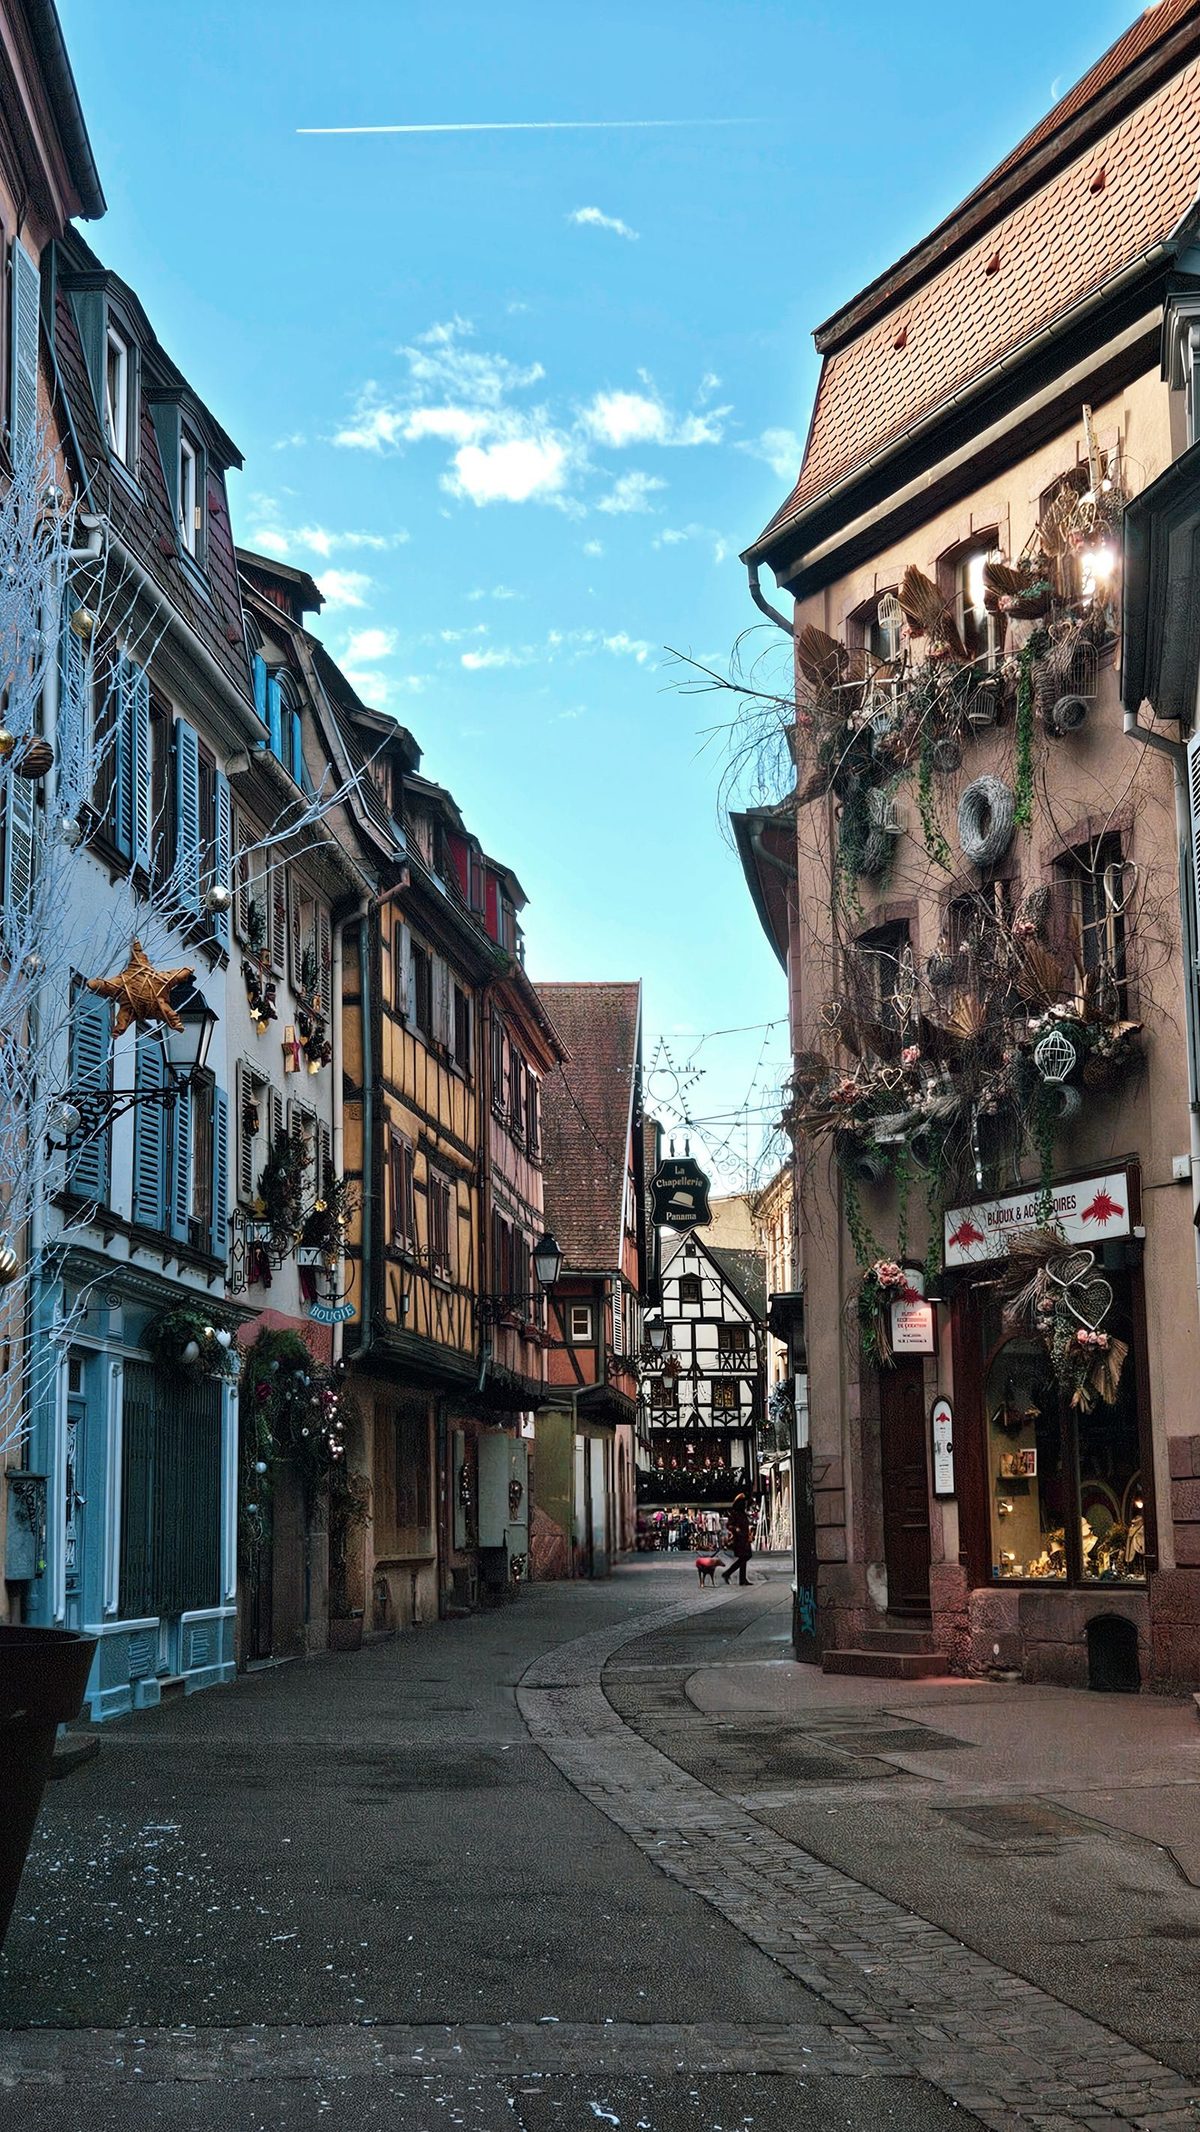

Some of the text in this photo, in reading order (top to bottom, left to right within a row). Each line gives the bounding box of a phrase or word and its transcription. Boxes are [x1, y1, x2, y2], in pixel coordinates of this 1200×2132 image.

[674, 1166, 685, 1175] La
[656, 1176, 703, 1188] Chapellerie
[666, 1211, 697, 1221] Panama
[987, 1207, 1015, 1226] BIJOUX
[1015, 1206, 1022, 1220] &
[310, 1304, 354, 1322] BOUGIE
